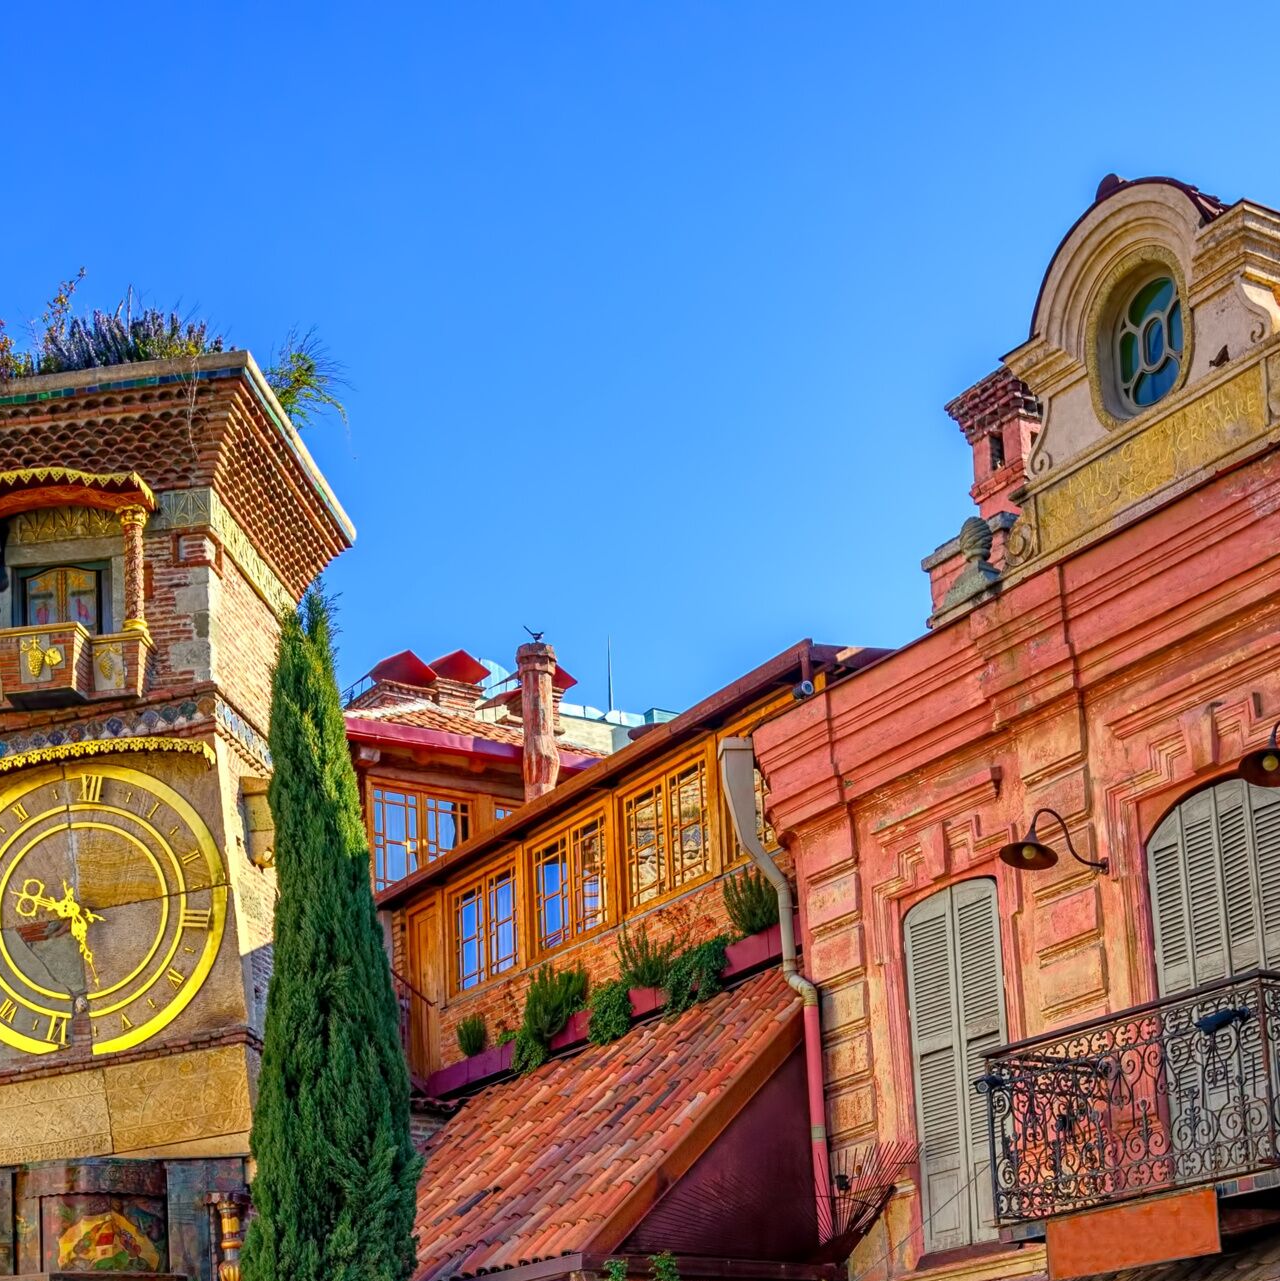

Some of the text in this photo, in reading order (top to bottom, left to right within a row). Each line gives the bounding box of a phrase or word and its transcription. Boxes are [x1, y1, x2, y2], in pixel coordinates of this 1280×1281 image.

[77, 773, 103, 803] XII
[181, 849, 201, 865] II
[180, 907, 211, 929] III
[121, 1012, 134, 1032] V
